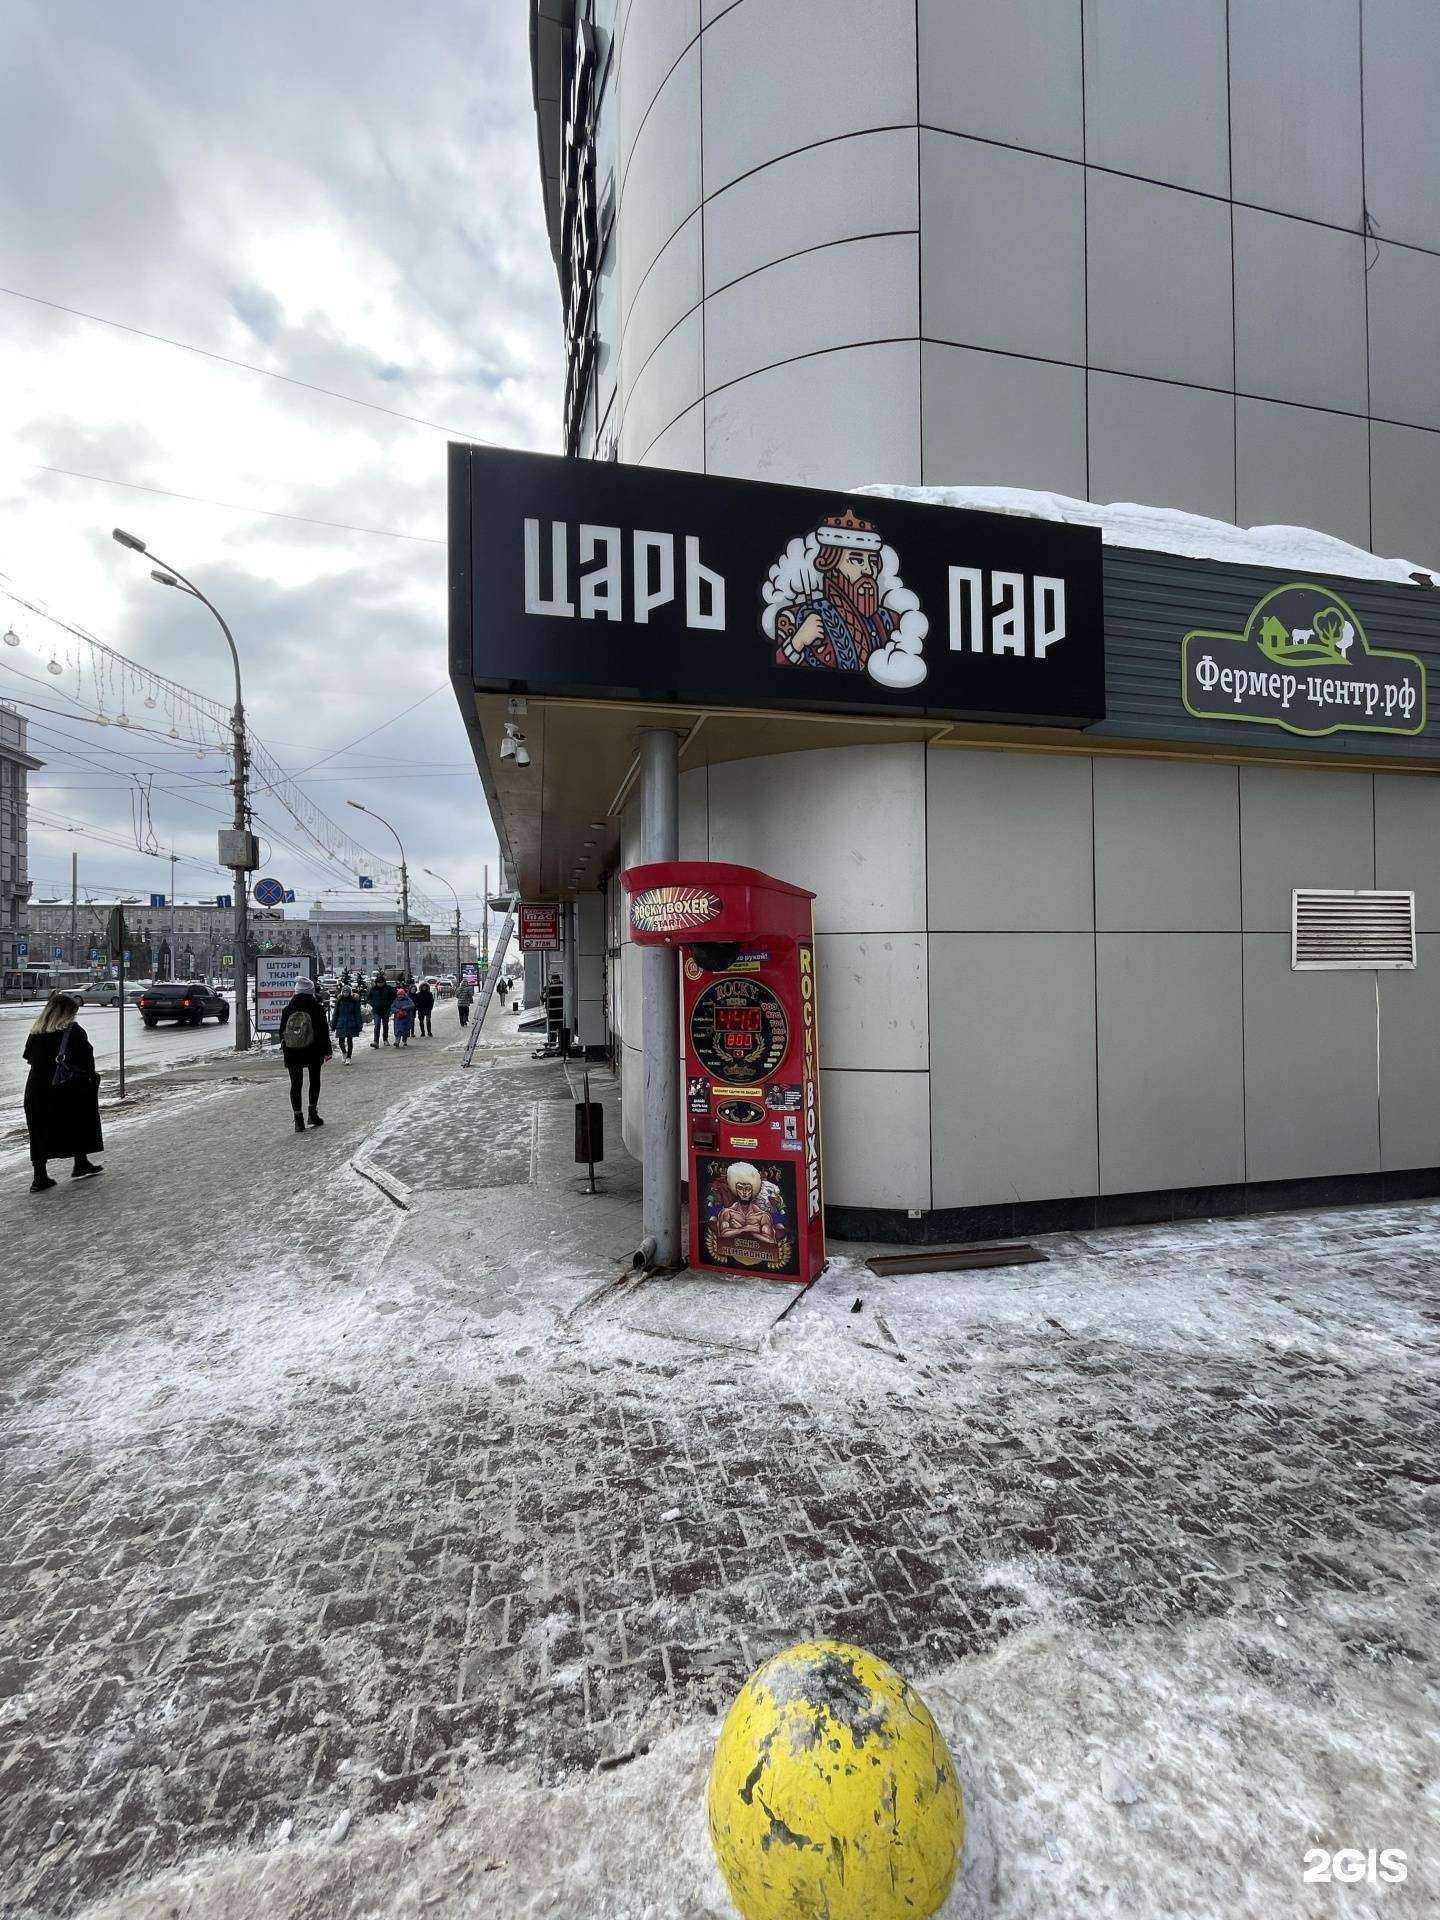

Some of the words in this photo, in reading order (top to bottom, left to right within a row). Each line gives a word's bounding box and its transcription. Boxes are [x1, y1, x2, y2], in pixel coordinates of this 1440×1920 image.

[524, 517, 726, 631] ЦАРЬ
[948, 565, 1065, 659] ПАР
[1195, 655, 1416, 718] Фермер-центр.рф
[635, 903, 663, 920] ROCKY
[666, 897, 709, 914] BOXER
[653, 919, 681, 929] START
[268, 971, 299, 979] ТКАНИ
[800, 949, 813, 1079] ROCKY
[806, 1081, 820, 1219] BOXER
